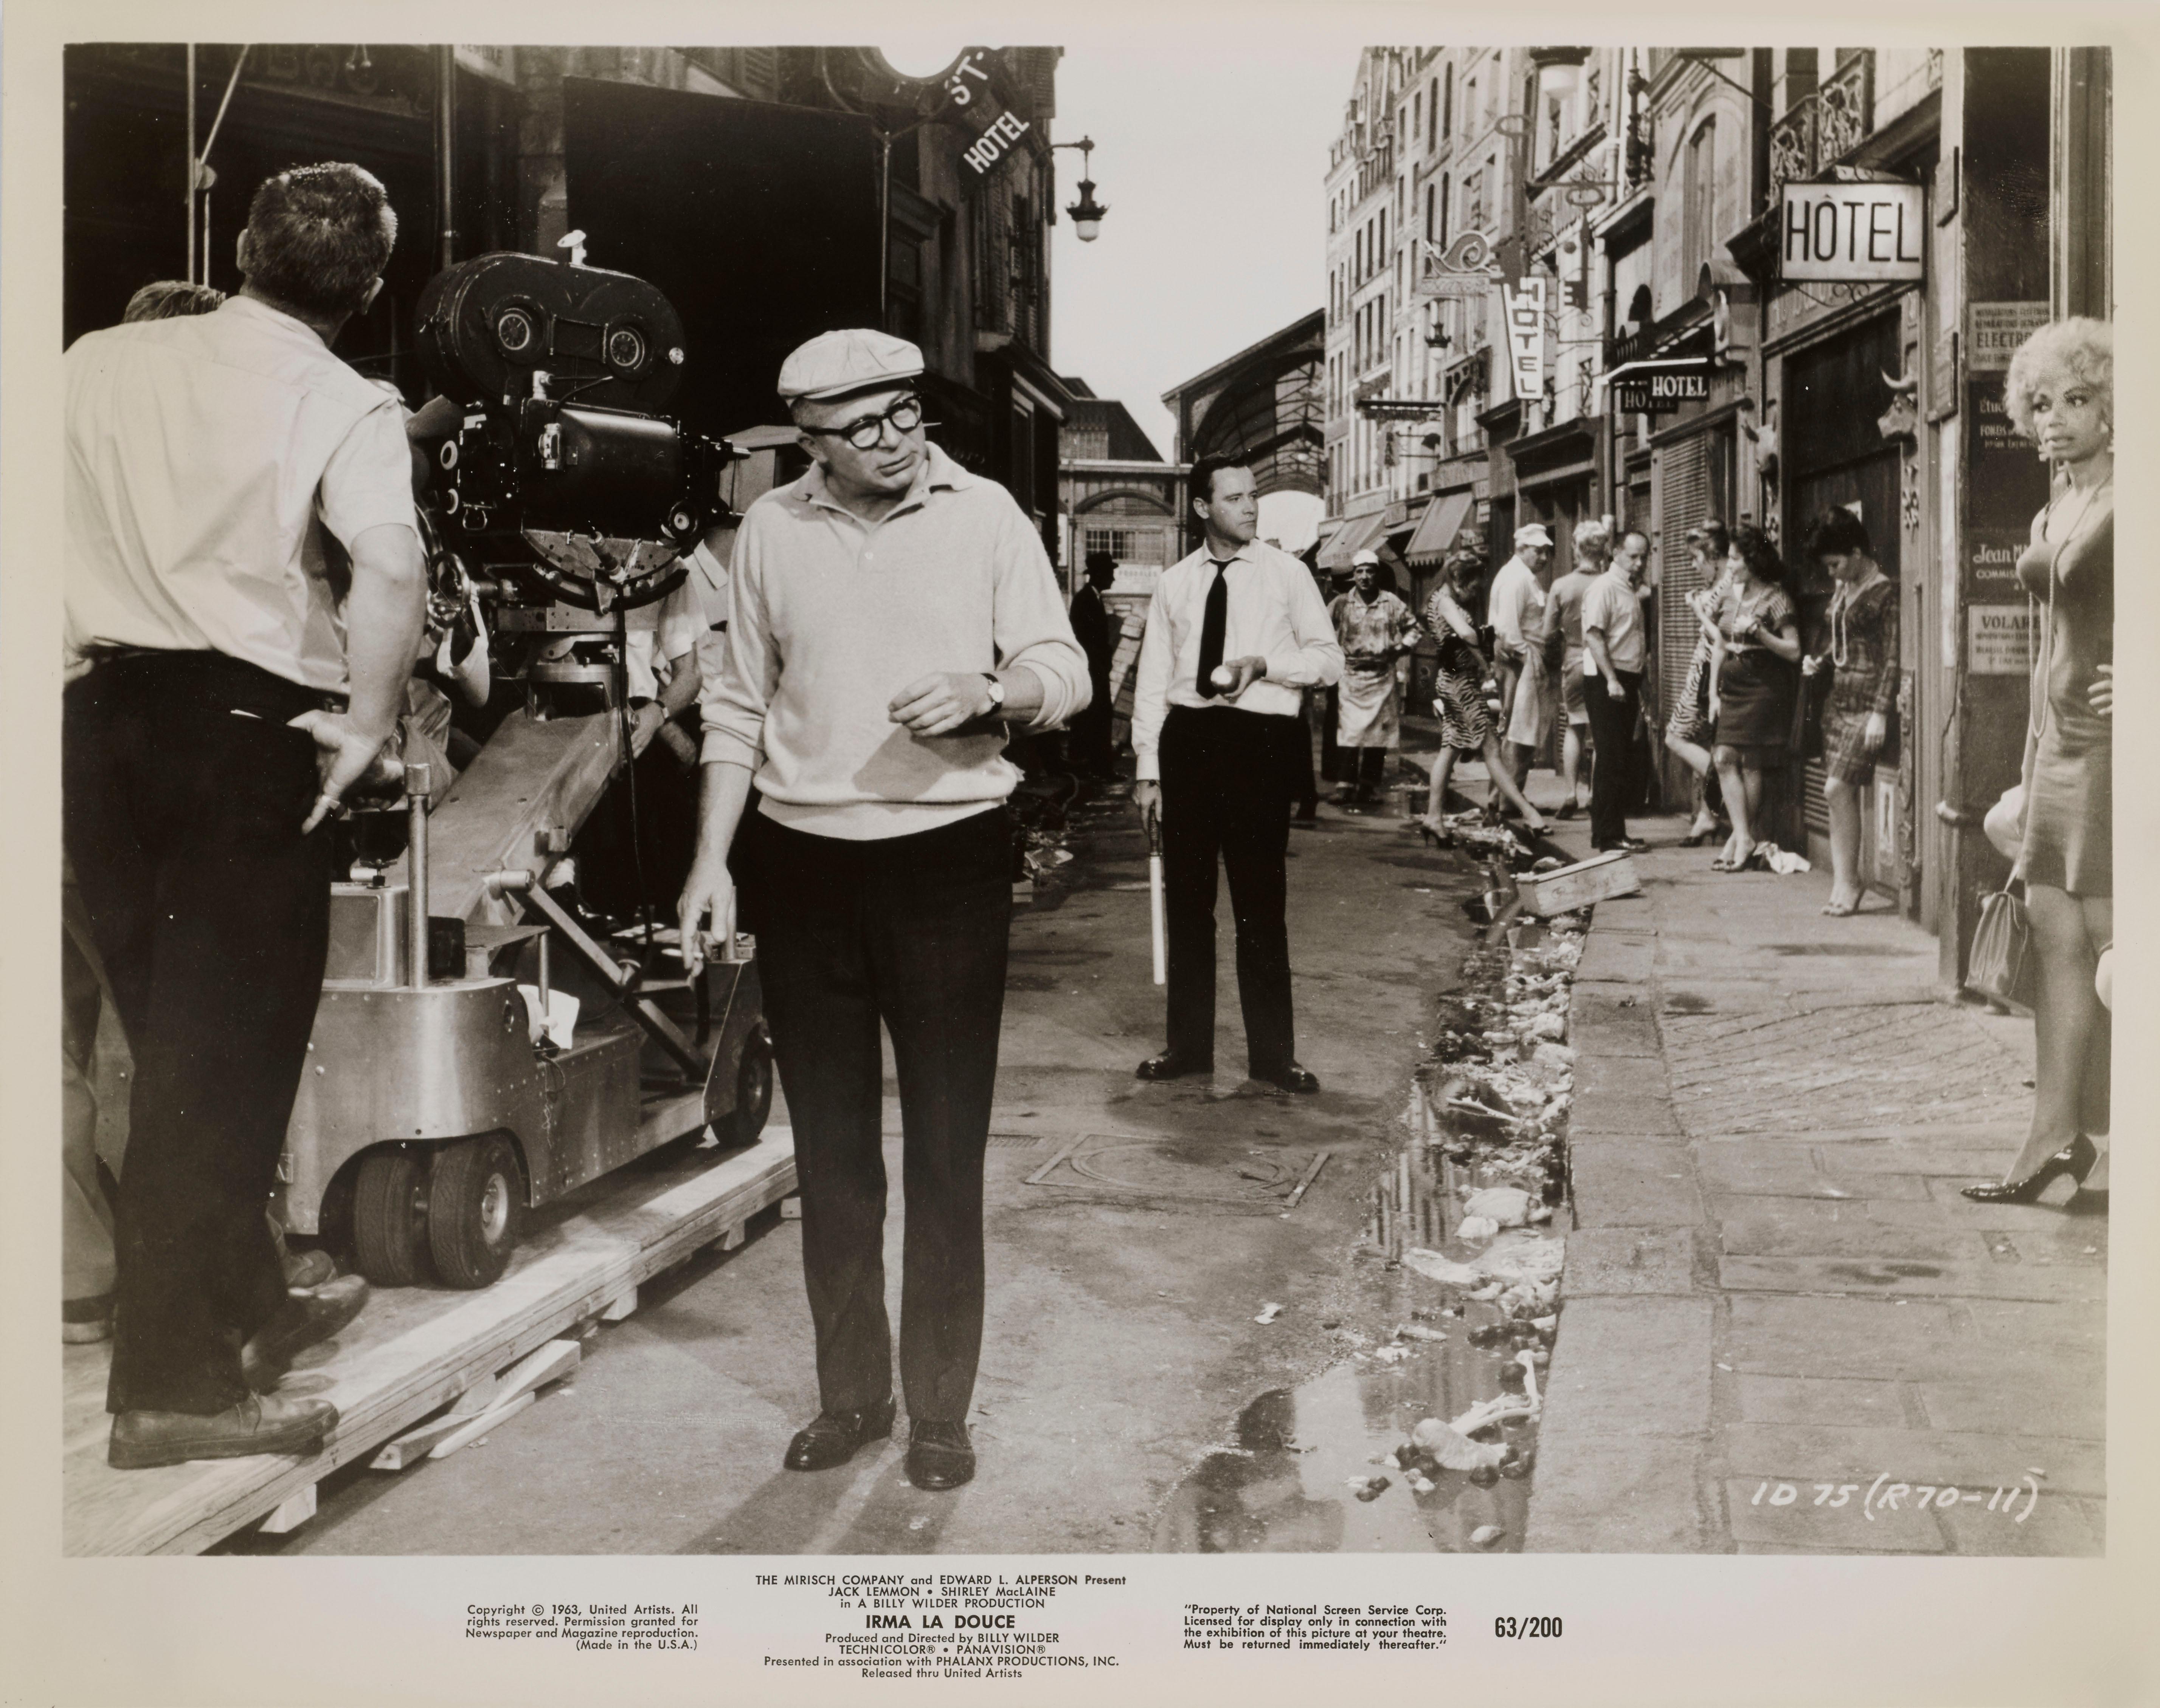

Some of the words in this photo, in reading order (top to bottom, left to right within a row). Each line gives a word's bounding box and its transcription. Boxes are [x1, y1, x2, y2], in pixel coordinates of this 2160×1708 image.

[963, 111, 1030, 174] HOTEL
[1786, 194, 1920, 262] HÔTEL
[1508, 282, 1539, 393] HOTEL
[1652, 376, 1707, 397] HOTEL
[1973, 544, 2011, 564] Jean
